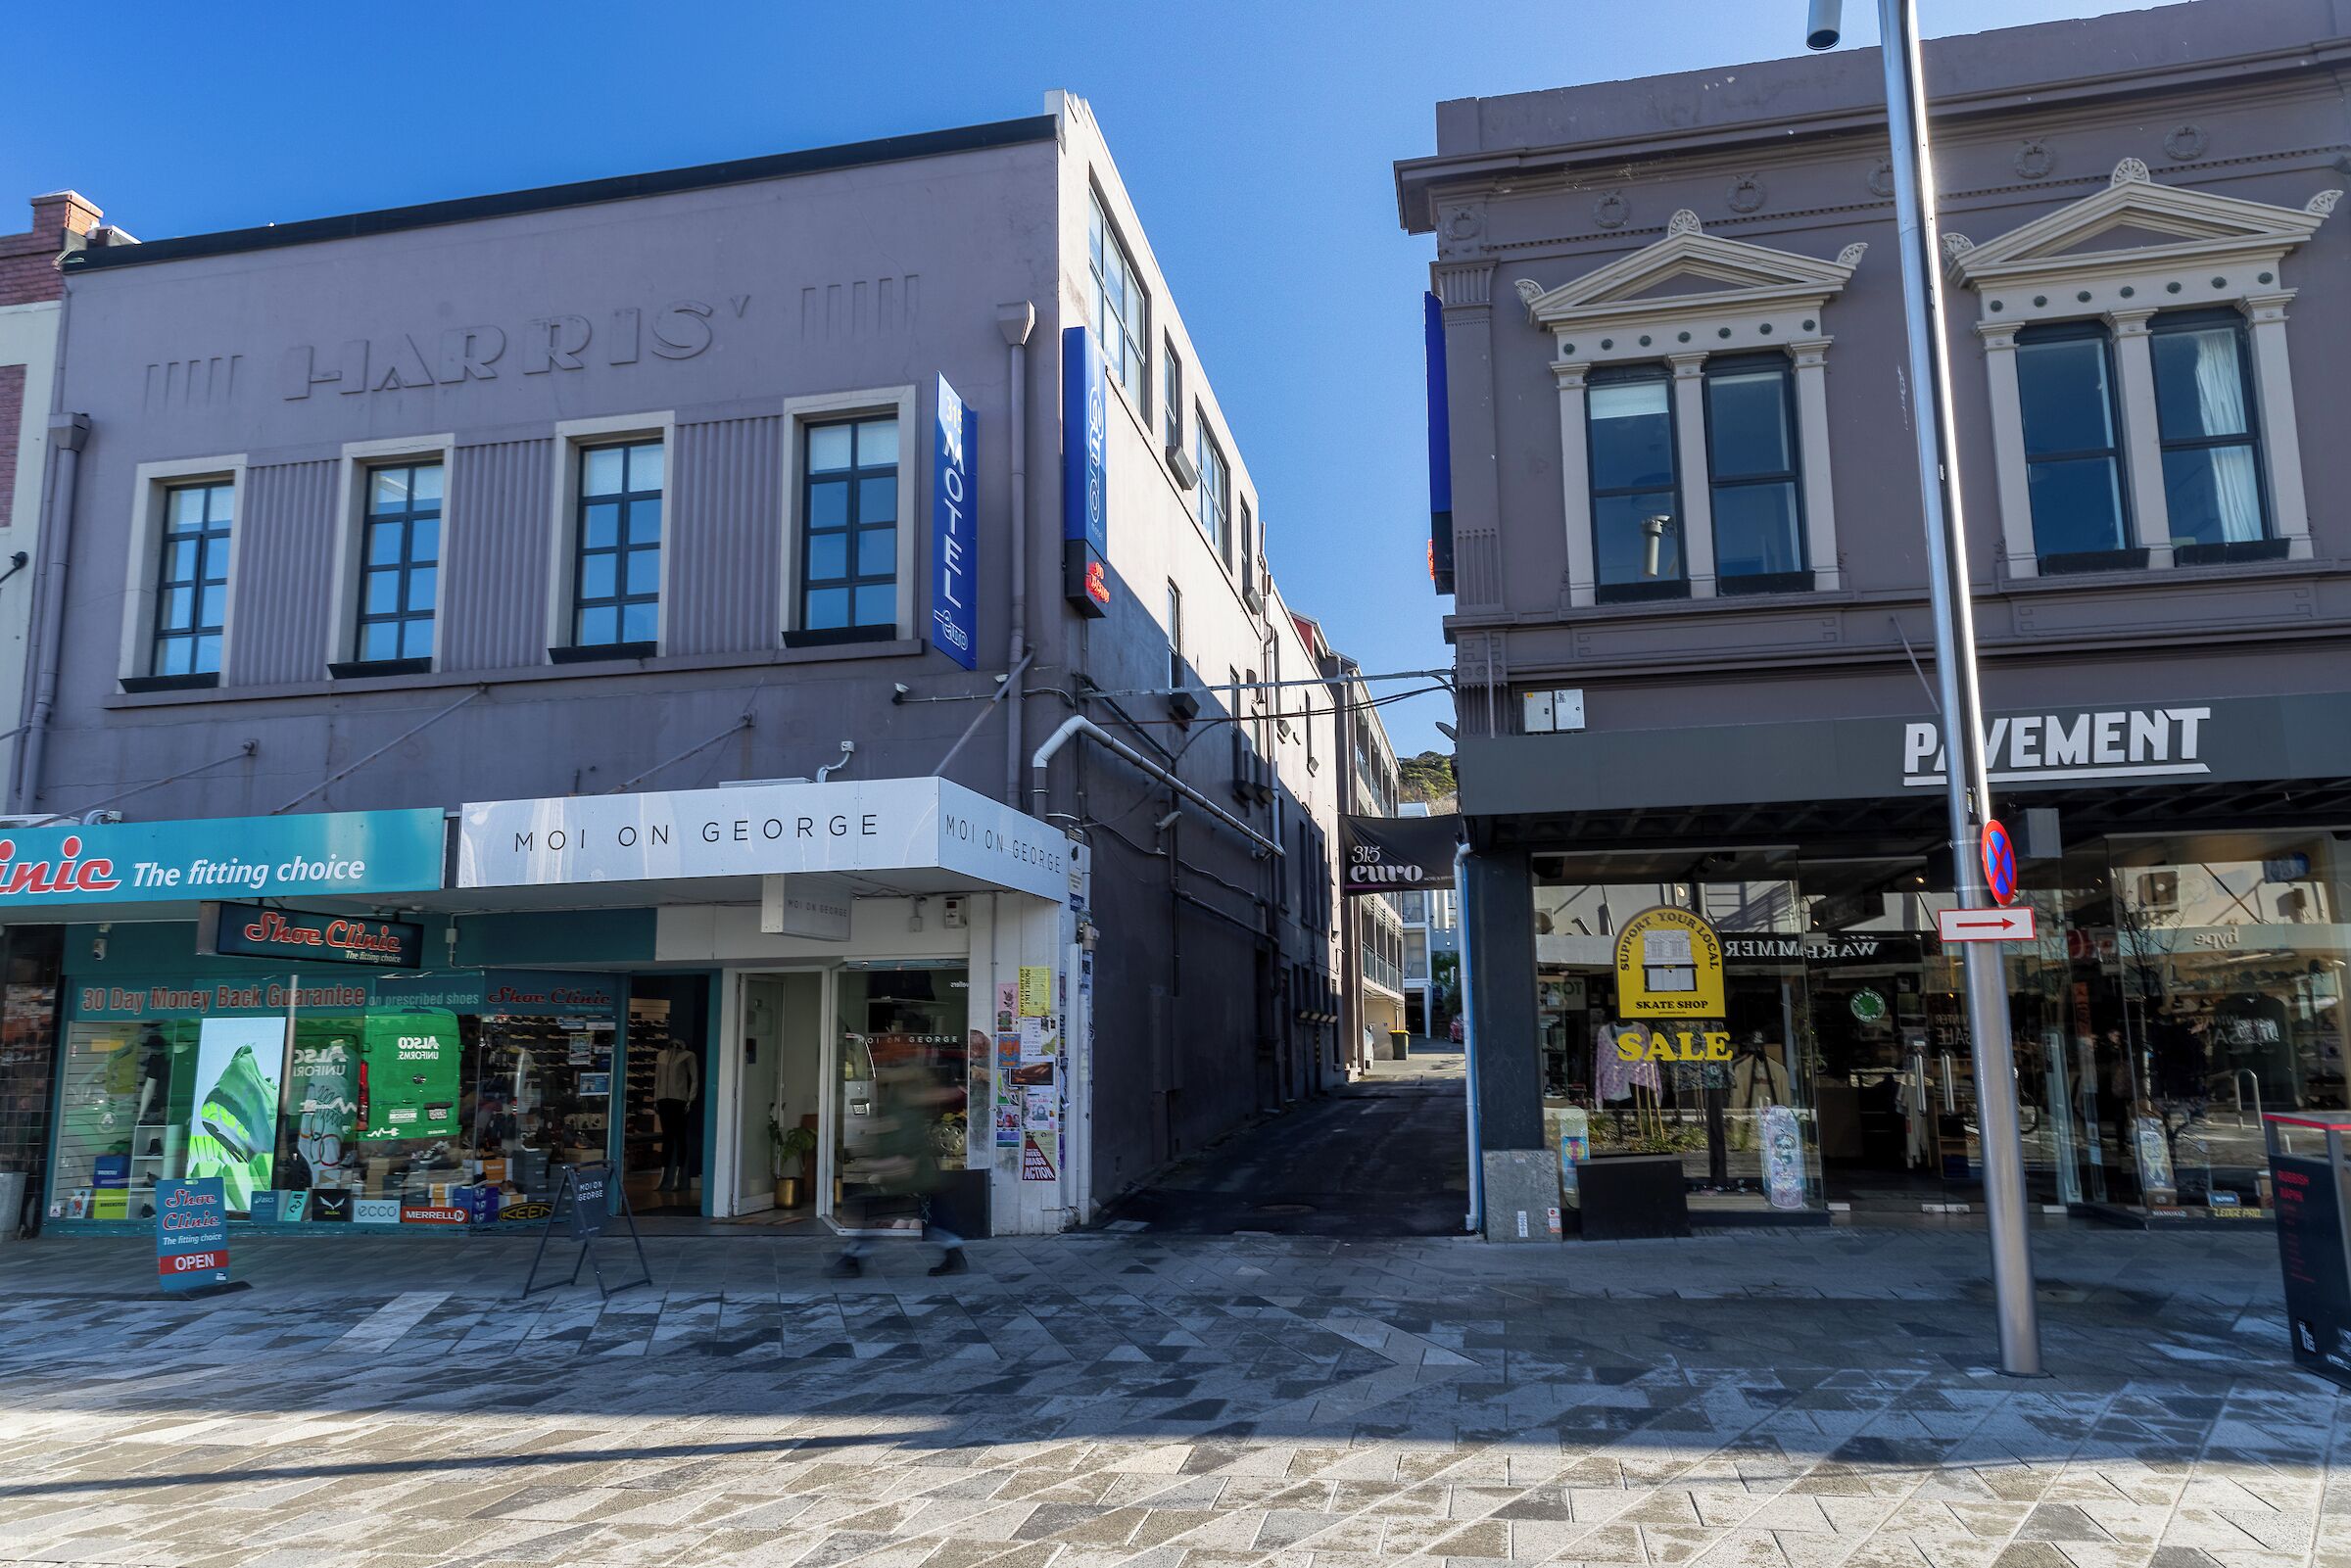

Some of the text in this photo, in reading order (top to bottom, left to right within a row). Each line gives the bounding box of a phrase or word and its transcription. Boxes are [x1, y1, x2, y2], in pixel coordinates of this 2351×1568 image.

[942, 429, 966, 609] MOTEL
[1903, 706, 2211, 774] PVEMENT
[515, 814, 878, 852] MOI ON GEORGE
[946, 814, 1061, 875] MOI ON GEORGE
[1352, 845, 1381, 863] 315
[133, 862, 181, 888] The
[187, 858, 268, 890] fitting
[276, 853, 365, 883] choice
[1350, 864, 1423, 882] euro
[244, 910, 403, 953] Shoe Clinic
[1619, 911, 1720, 972] SUPPORT YOUR LOCAL
[345, 950, 402, 963] The fitting choice
[82, 982, 480, 1016] 30 Day Money Back Guarantee on prescribed shoes
[488, 986, 612, 1005] Shoe Clinic
[1635, 1000, 1708, 1010] SKATE SHOP
[1616, 1031, 1733, 1063] SALE
[1025, 1157, 1046, 1166] MASS
[1024, 1165, 1055, 1180] ACTION
[165, 1188, 217, 1209] Shoe
[578, 1190, 603, 1202] GEORGE
[358, 1204, 397, 1217] ecco
[406, 1211, 452, 1220] MERRELL
[503, 1205, 552, 1220] KEEN
[163, 1211, 221, 1231] Clinic
[163, 1232, 223, 1246] The fitting choice
[174, 1253, 216, 1271] OPEN
